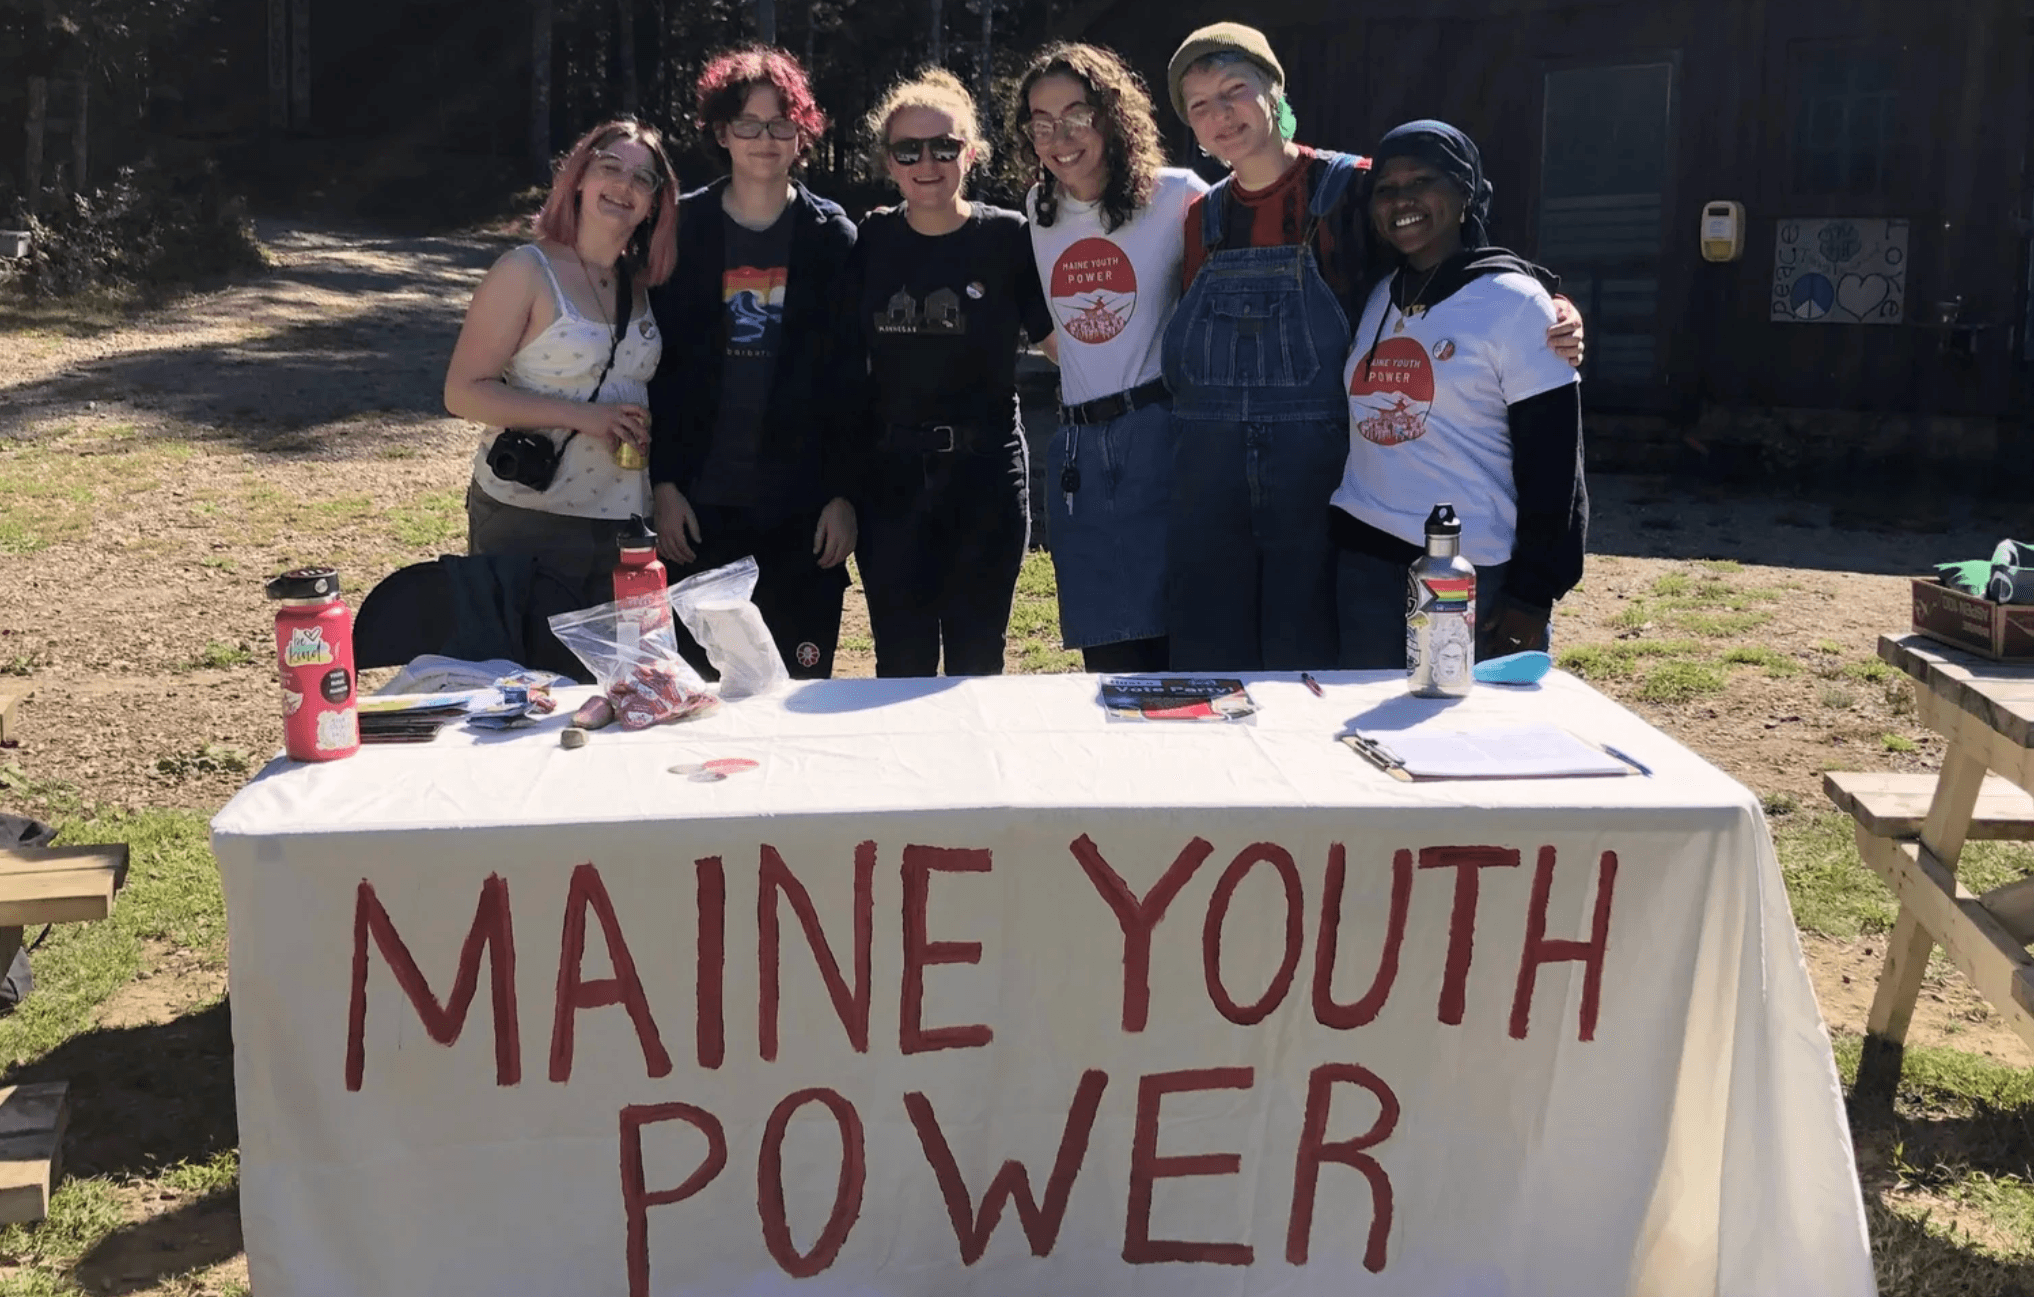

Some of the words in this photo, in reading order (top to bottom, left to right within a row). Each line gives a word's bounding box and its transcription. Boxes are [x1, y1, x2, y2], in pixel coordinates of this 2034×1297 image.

[1062, 260, 1089, 271] MAINE
[1091, 257, 1119, 268] YOUTH
[1067, 270, 1112, 284] POWER
[1370, 358, 1391, 367] AINE
[1393, 358, 1421, 369] YOUTH
[1368, 371, 1411, 383] POWER
[293, 629, 306, 647] be
[289, 640, 321, 664] kind
[346, 840, 993, 1091] MAINE
[1069, 833, 1618, 1042] YOUTH
[619, 1062, 1401, 1297] POWER
